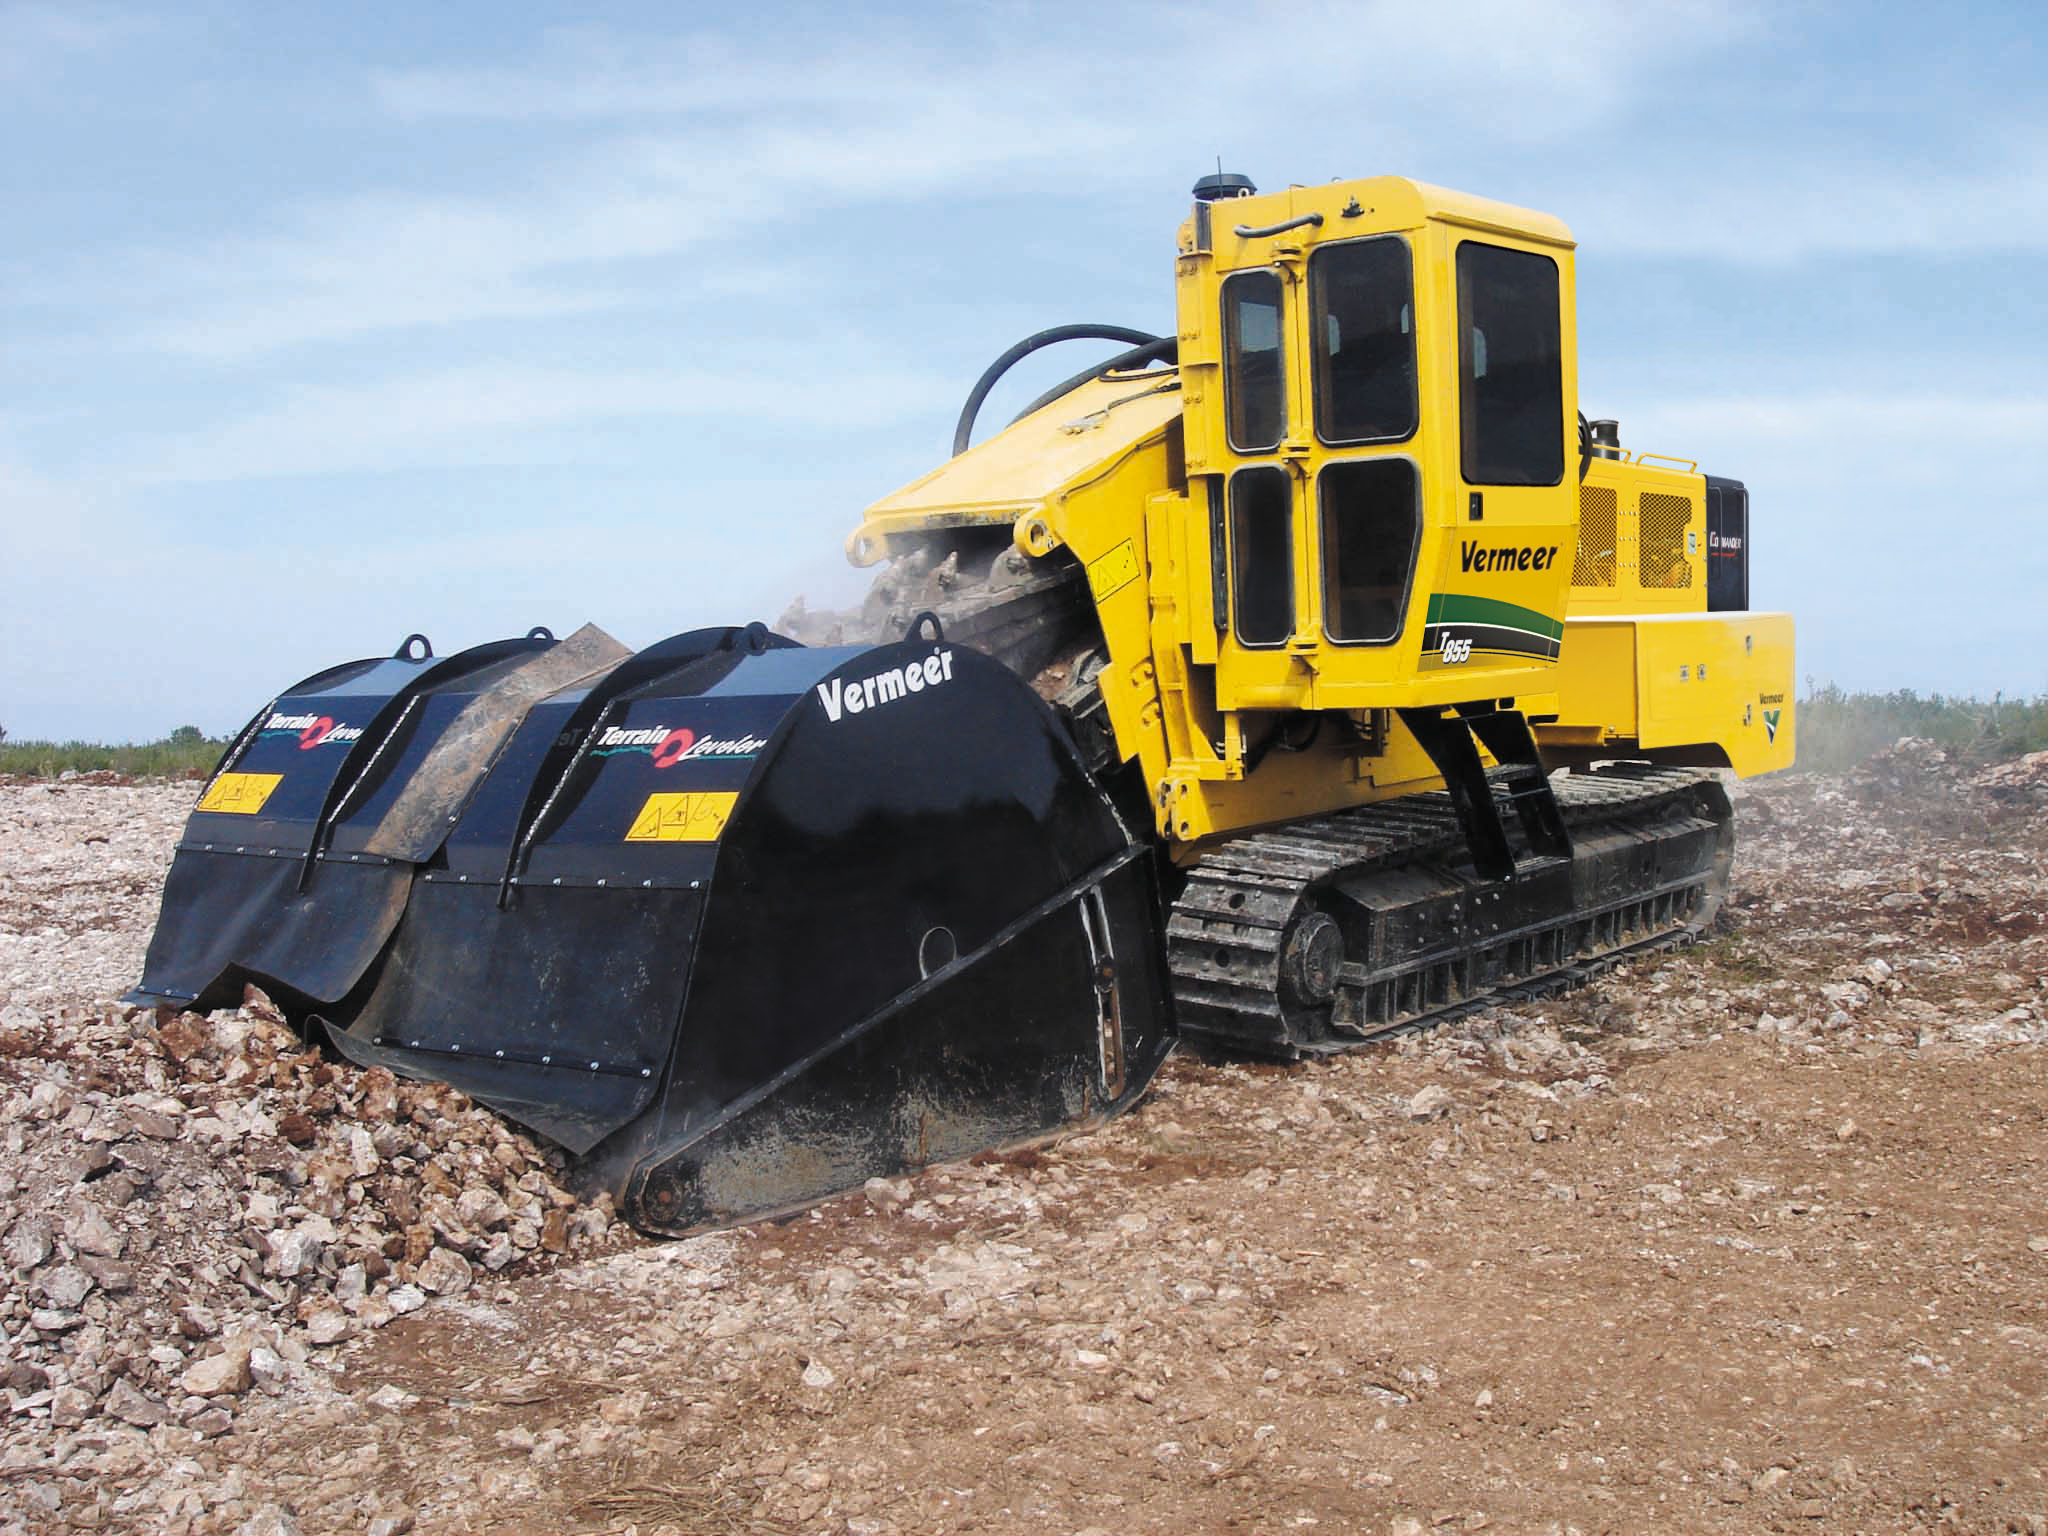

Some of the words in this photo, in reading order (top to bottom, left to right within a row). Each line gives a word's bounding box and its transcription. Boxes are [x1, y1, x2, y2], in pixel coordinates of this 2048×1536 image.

[1461, 540, 1559, 573] Vermeer
[1439, 631, 1472, 664] T855
[816, 650, 953, 723] Vermeer
[1759, 693, 1784, 705] Vermeer
[264, 712, 319, 729] Terrain
[597, 725, 671, 746] Terrain
[677, 734, 768, 762] Leveler
